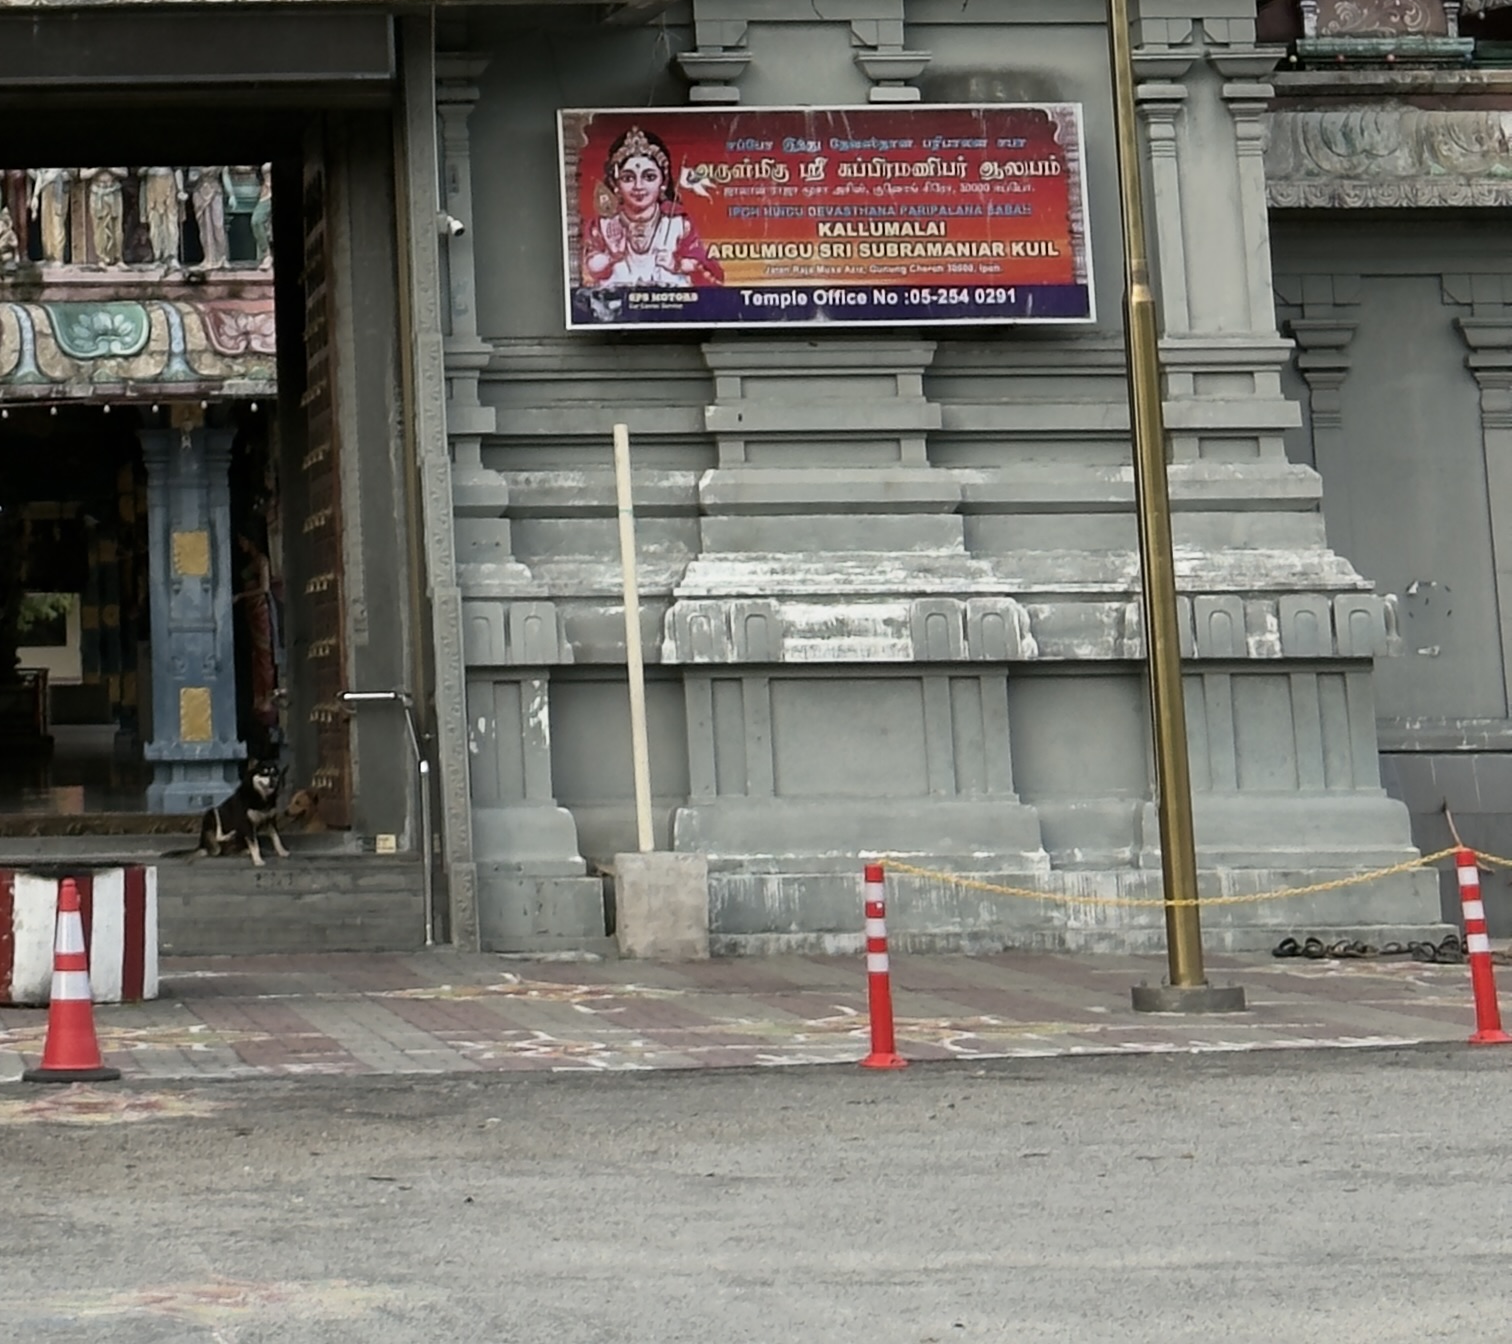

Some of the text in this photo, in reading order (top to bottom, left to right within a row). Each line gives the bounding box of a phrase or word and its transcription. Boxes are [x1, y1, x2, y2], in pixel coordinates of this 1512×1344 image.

[694, 157, 790, 184] அருள்மிகு
[978, 154, 1062, 180] ஆலயம்
[727, 205, 760, 218] IPOH
[762, 205, 805, 218] HINDU
[807, 204, 896, 217] DEVASTHANA
[899, 203, 984, 216] PARIPALANA
[818, 220, 947, 237] KALLUMALAI
[706, 240, 1061, 260] ARULMIGU SRI SUBRAMANIAR KUIL
[765, 265, 790, 275] Jalan
[792, 264, 815, 276] Raja
[869, 263, 907, 276] Gunung
[651, 292, 698, 302] MOTORS
[740, 289, 808, 310] Temple
[812, 288, 868, 306] Office
[872, 288, 899, 305] No
[974, 287, 1016, 304] 0291
